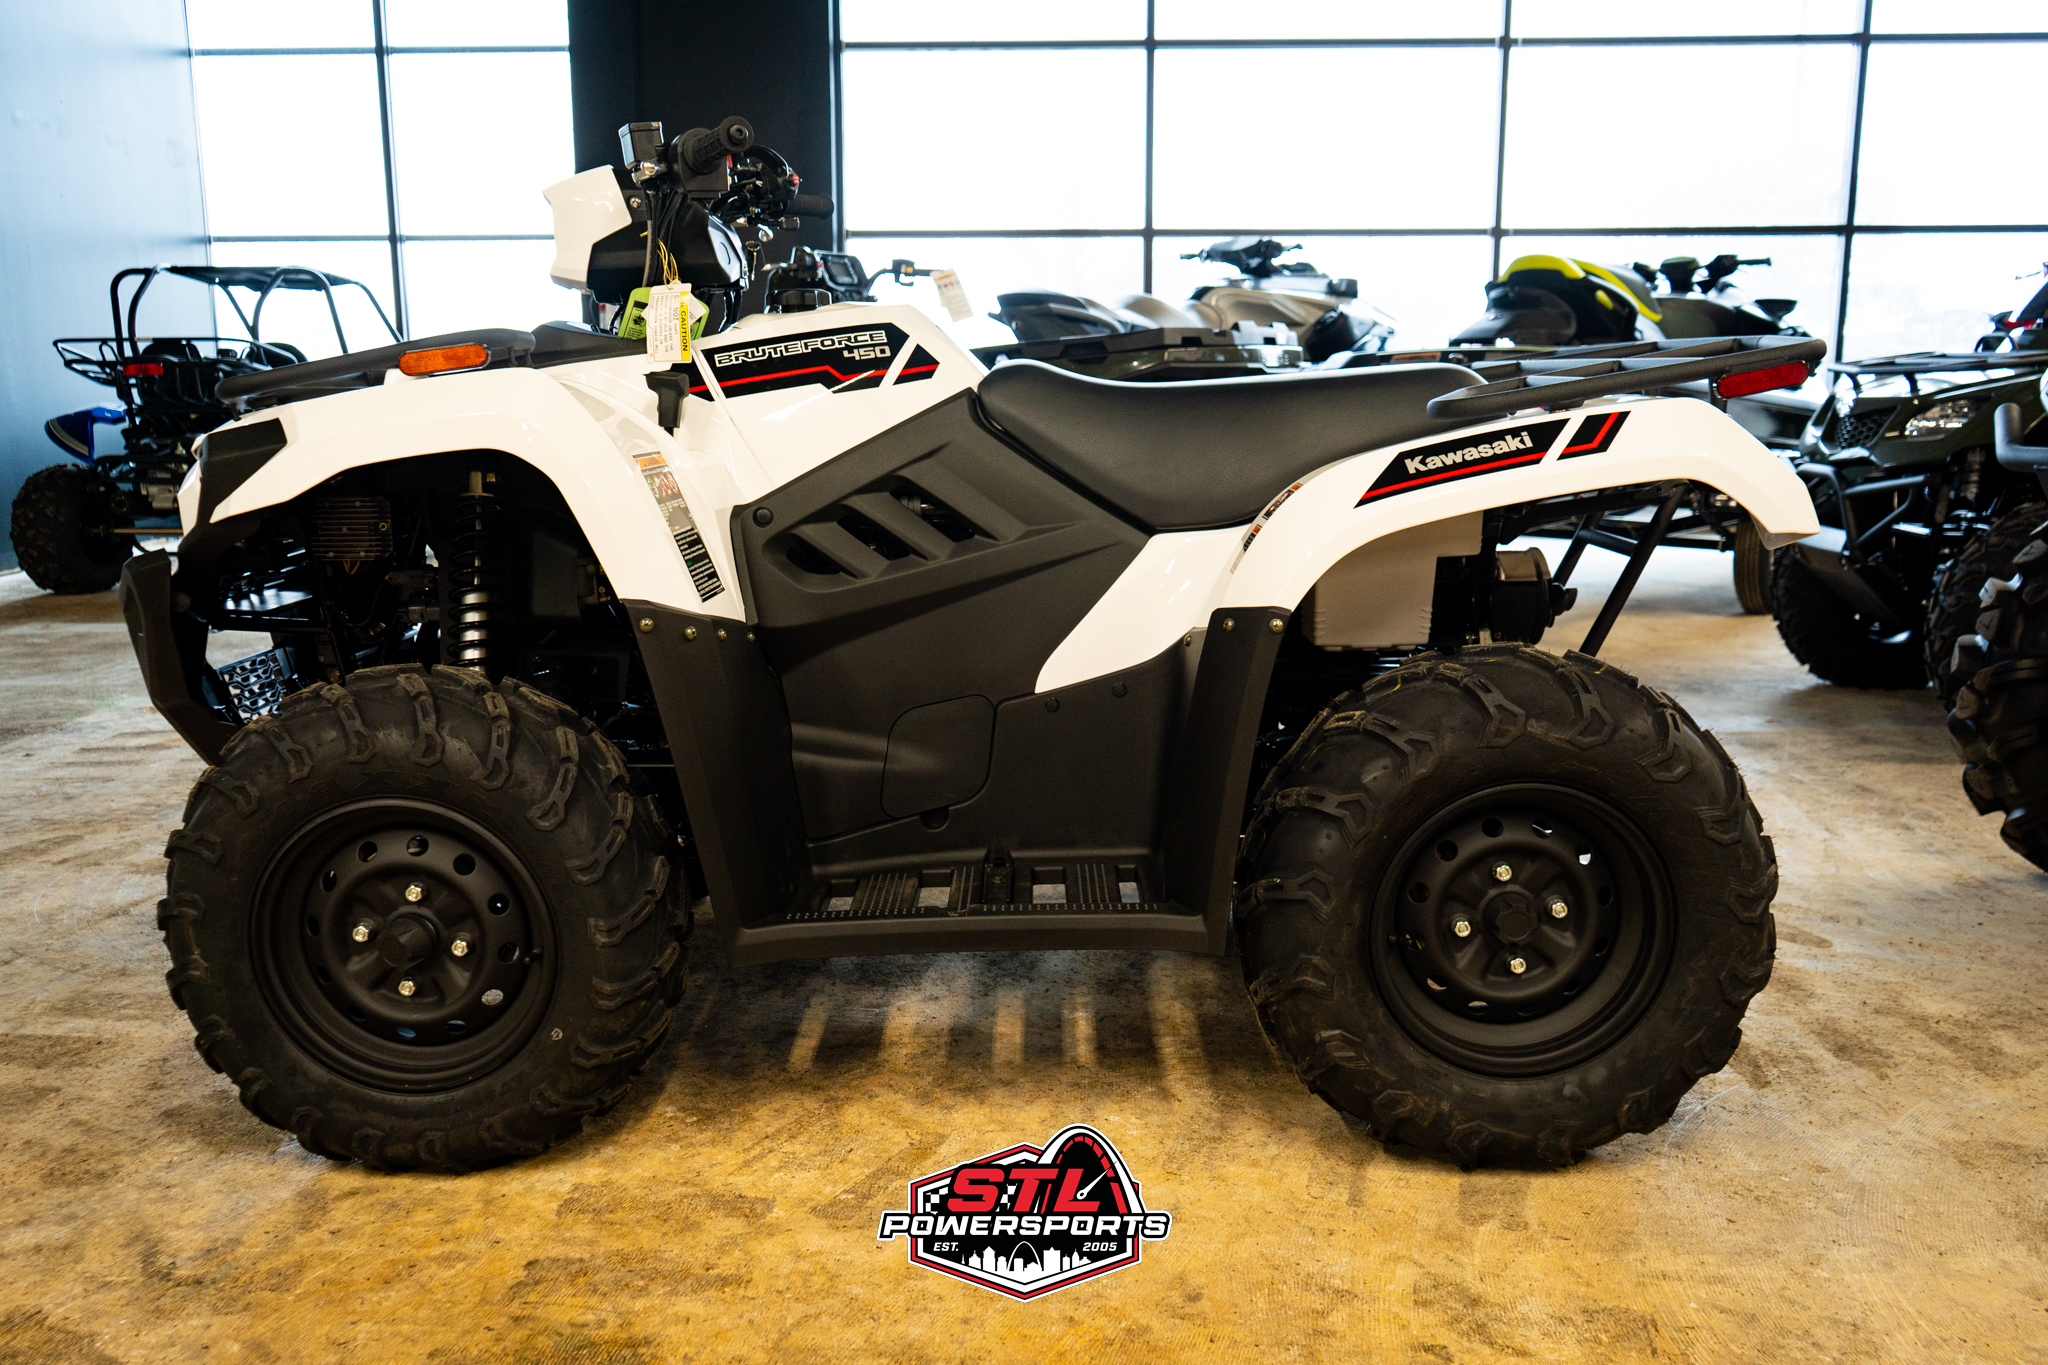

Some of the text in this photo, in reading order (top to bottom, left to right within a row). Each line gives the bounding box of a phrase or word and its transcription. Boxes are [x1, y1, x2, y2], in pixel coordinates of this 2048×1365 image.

[674, 295, 679, 304] DO
[843, 345, 891, 361] 450
[1405, 431, 1533, 474] Kawasaki
